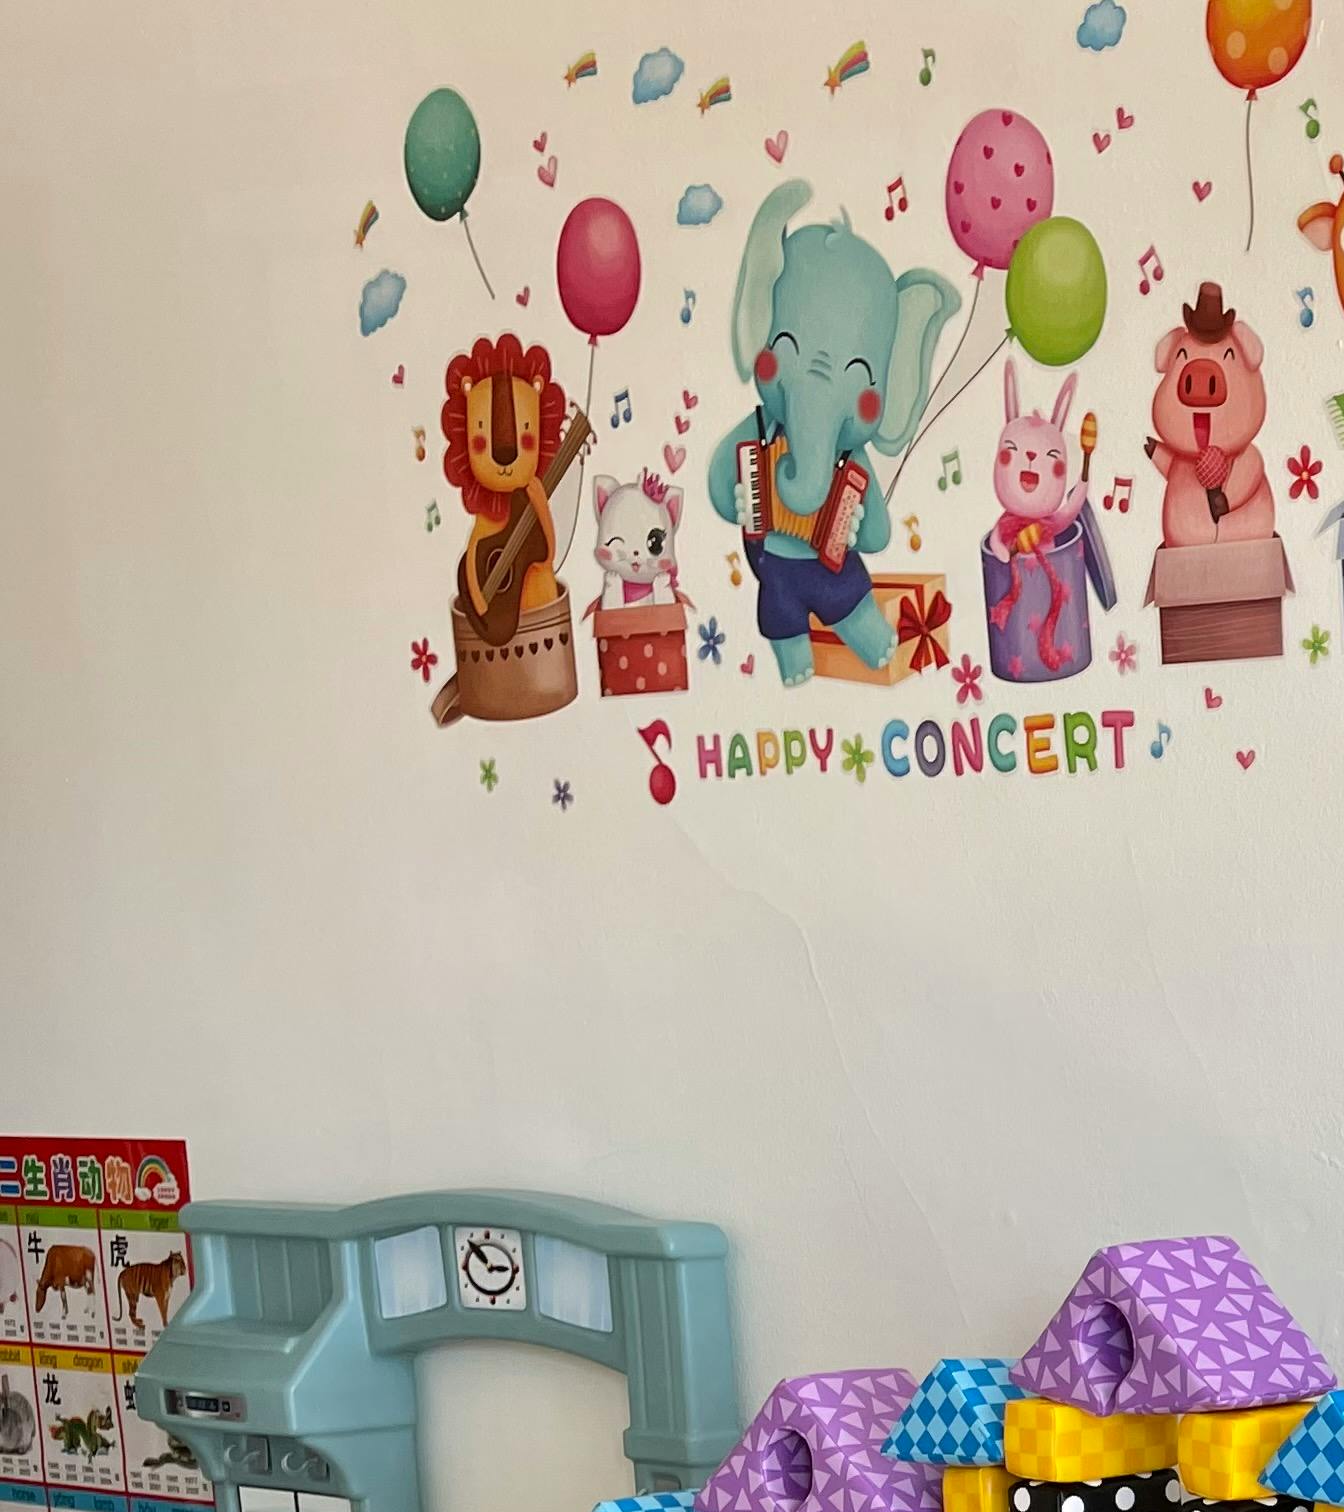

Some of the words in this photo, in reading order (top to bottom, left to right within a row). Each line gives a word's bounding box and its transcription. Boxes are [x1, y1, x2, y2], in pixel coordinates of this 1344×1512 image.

[698, 727, 833, 778] HAPPY
[881, 709, 1135, 778] CONCERT
[0, 1154, 133, 1203] 二生肖动物
[28, 1230, 45, 1264] 牛
[110, 1234, 131, 1268] 虎
[42, 1372, 62, 1405] 龙
